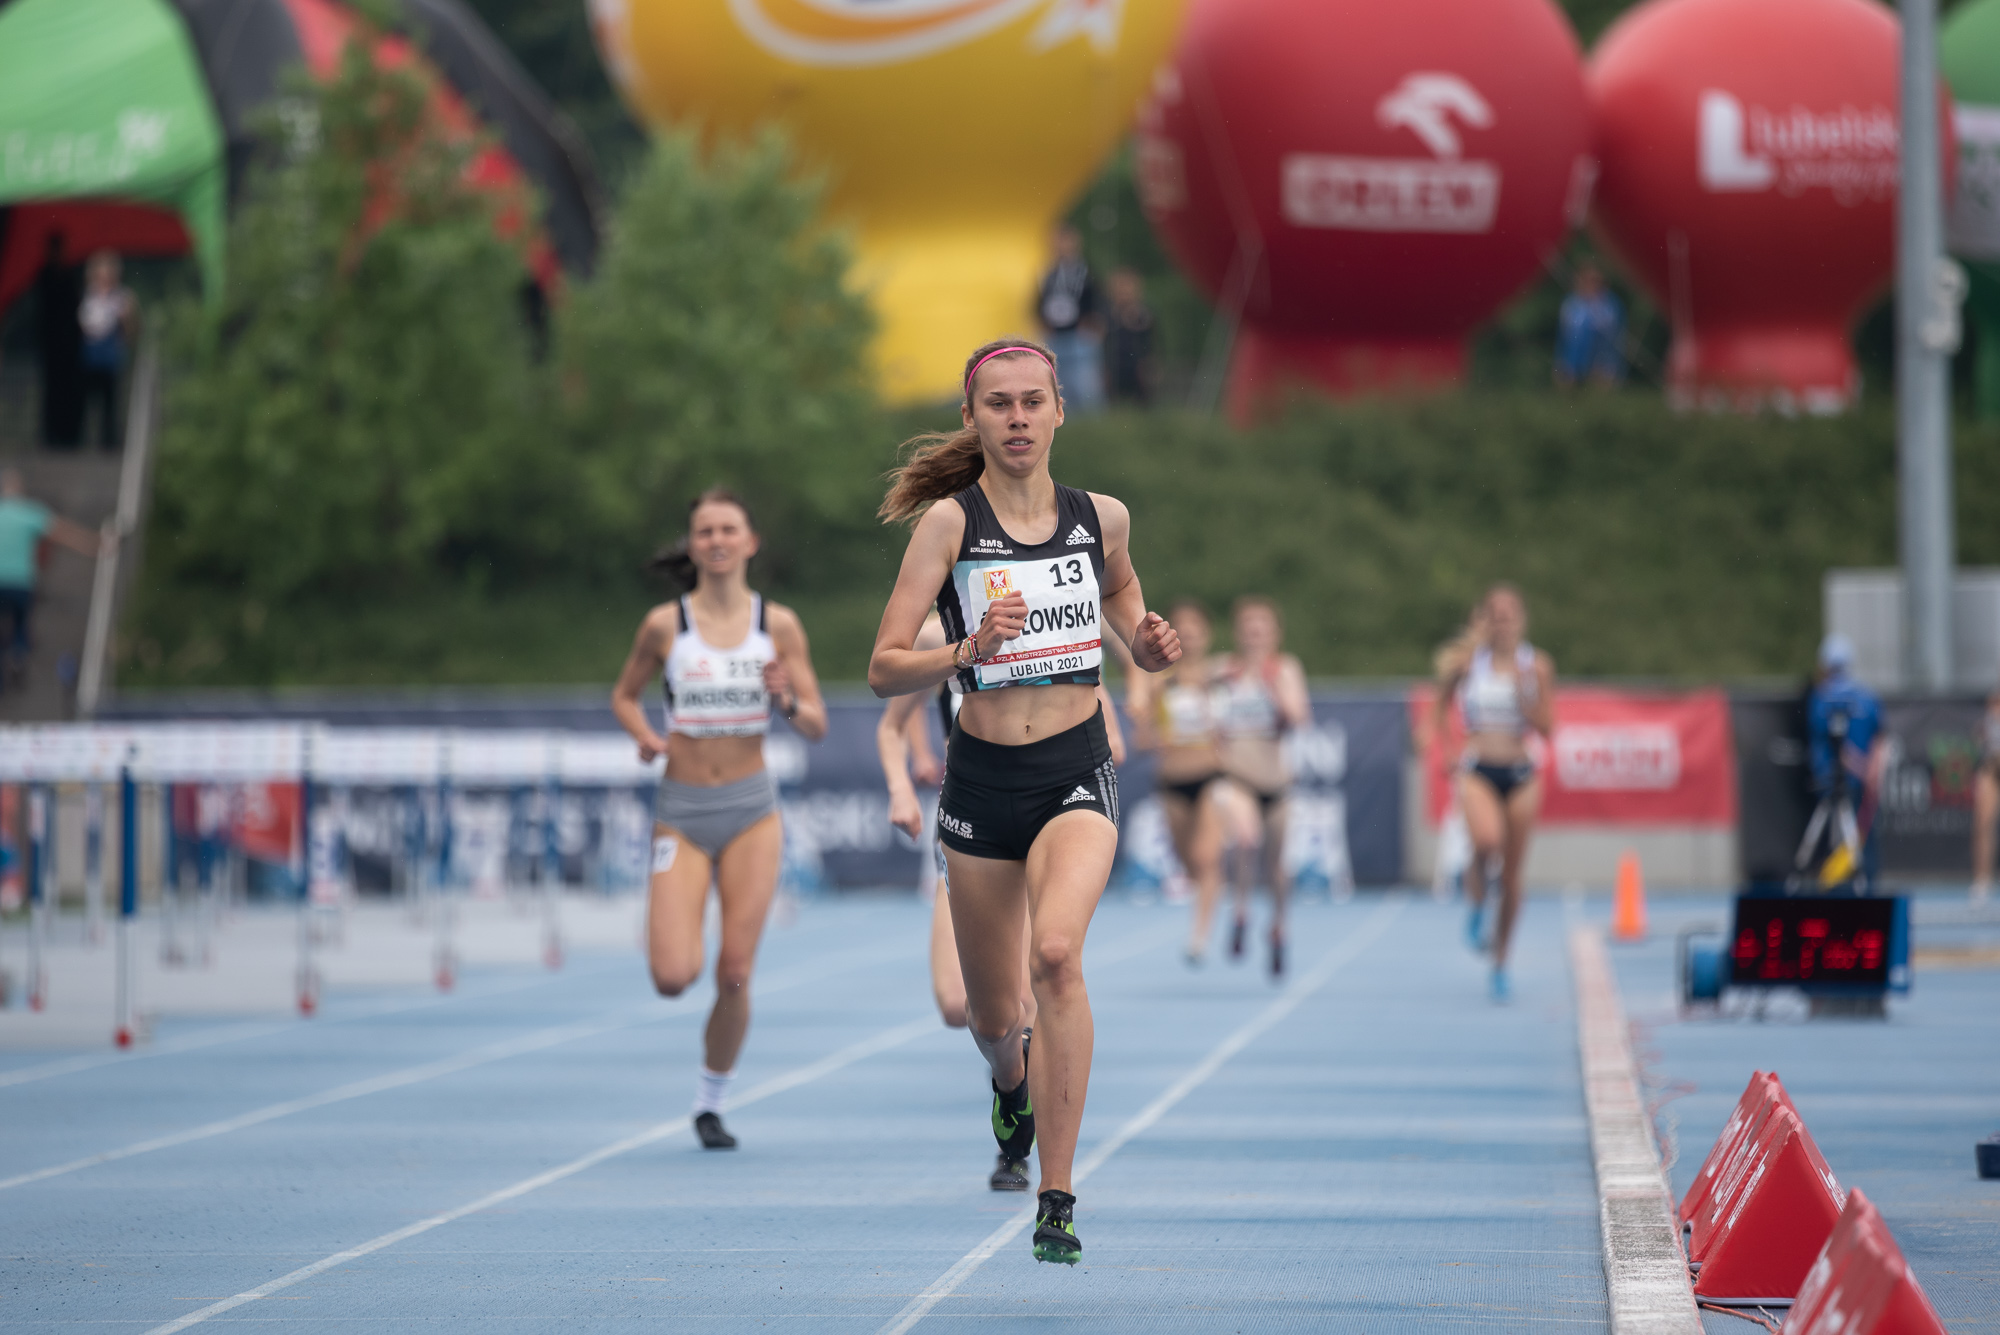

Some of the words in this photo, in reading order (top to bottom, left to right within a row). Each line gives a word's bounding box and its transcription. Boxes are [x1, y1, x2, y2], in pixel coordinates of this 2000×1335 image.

[979, 539, 1003, 548] SMS
[1066, 536, 1096, 545] adidas
[1049, 559, 1083, 587] 13
[1016, 647, 1066, 659] MISTRZOSTWA
[1010, 661, 1053, 677] LUBLIN
[1057, 656, 1083, 670] 2021
[1063, 795, 1096, 805] adidas
[939, 808, 973, 834] SMS
